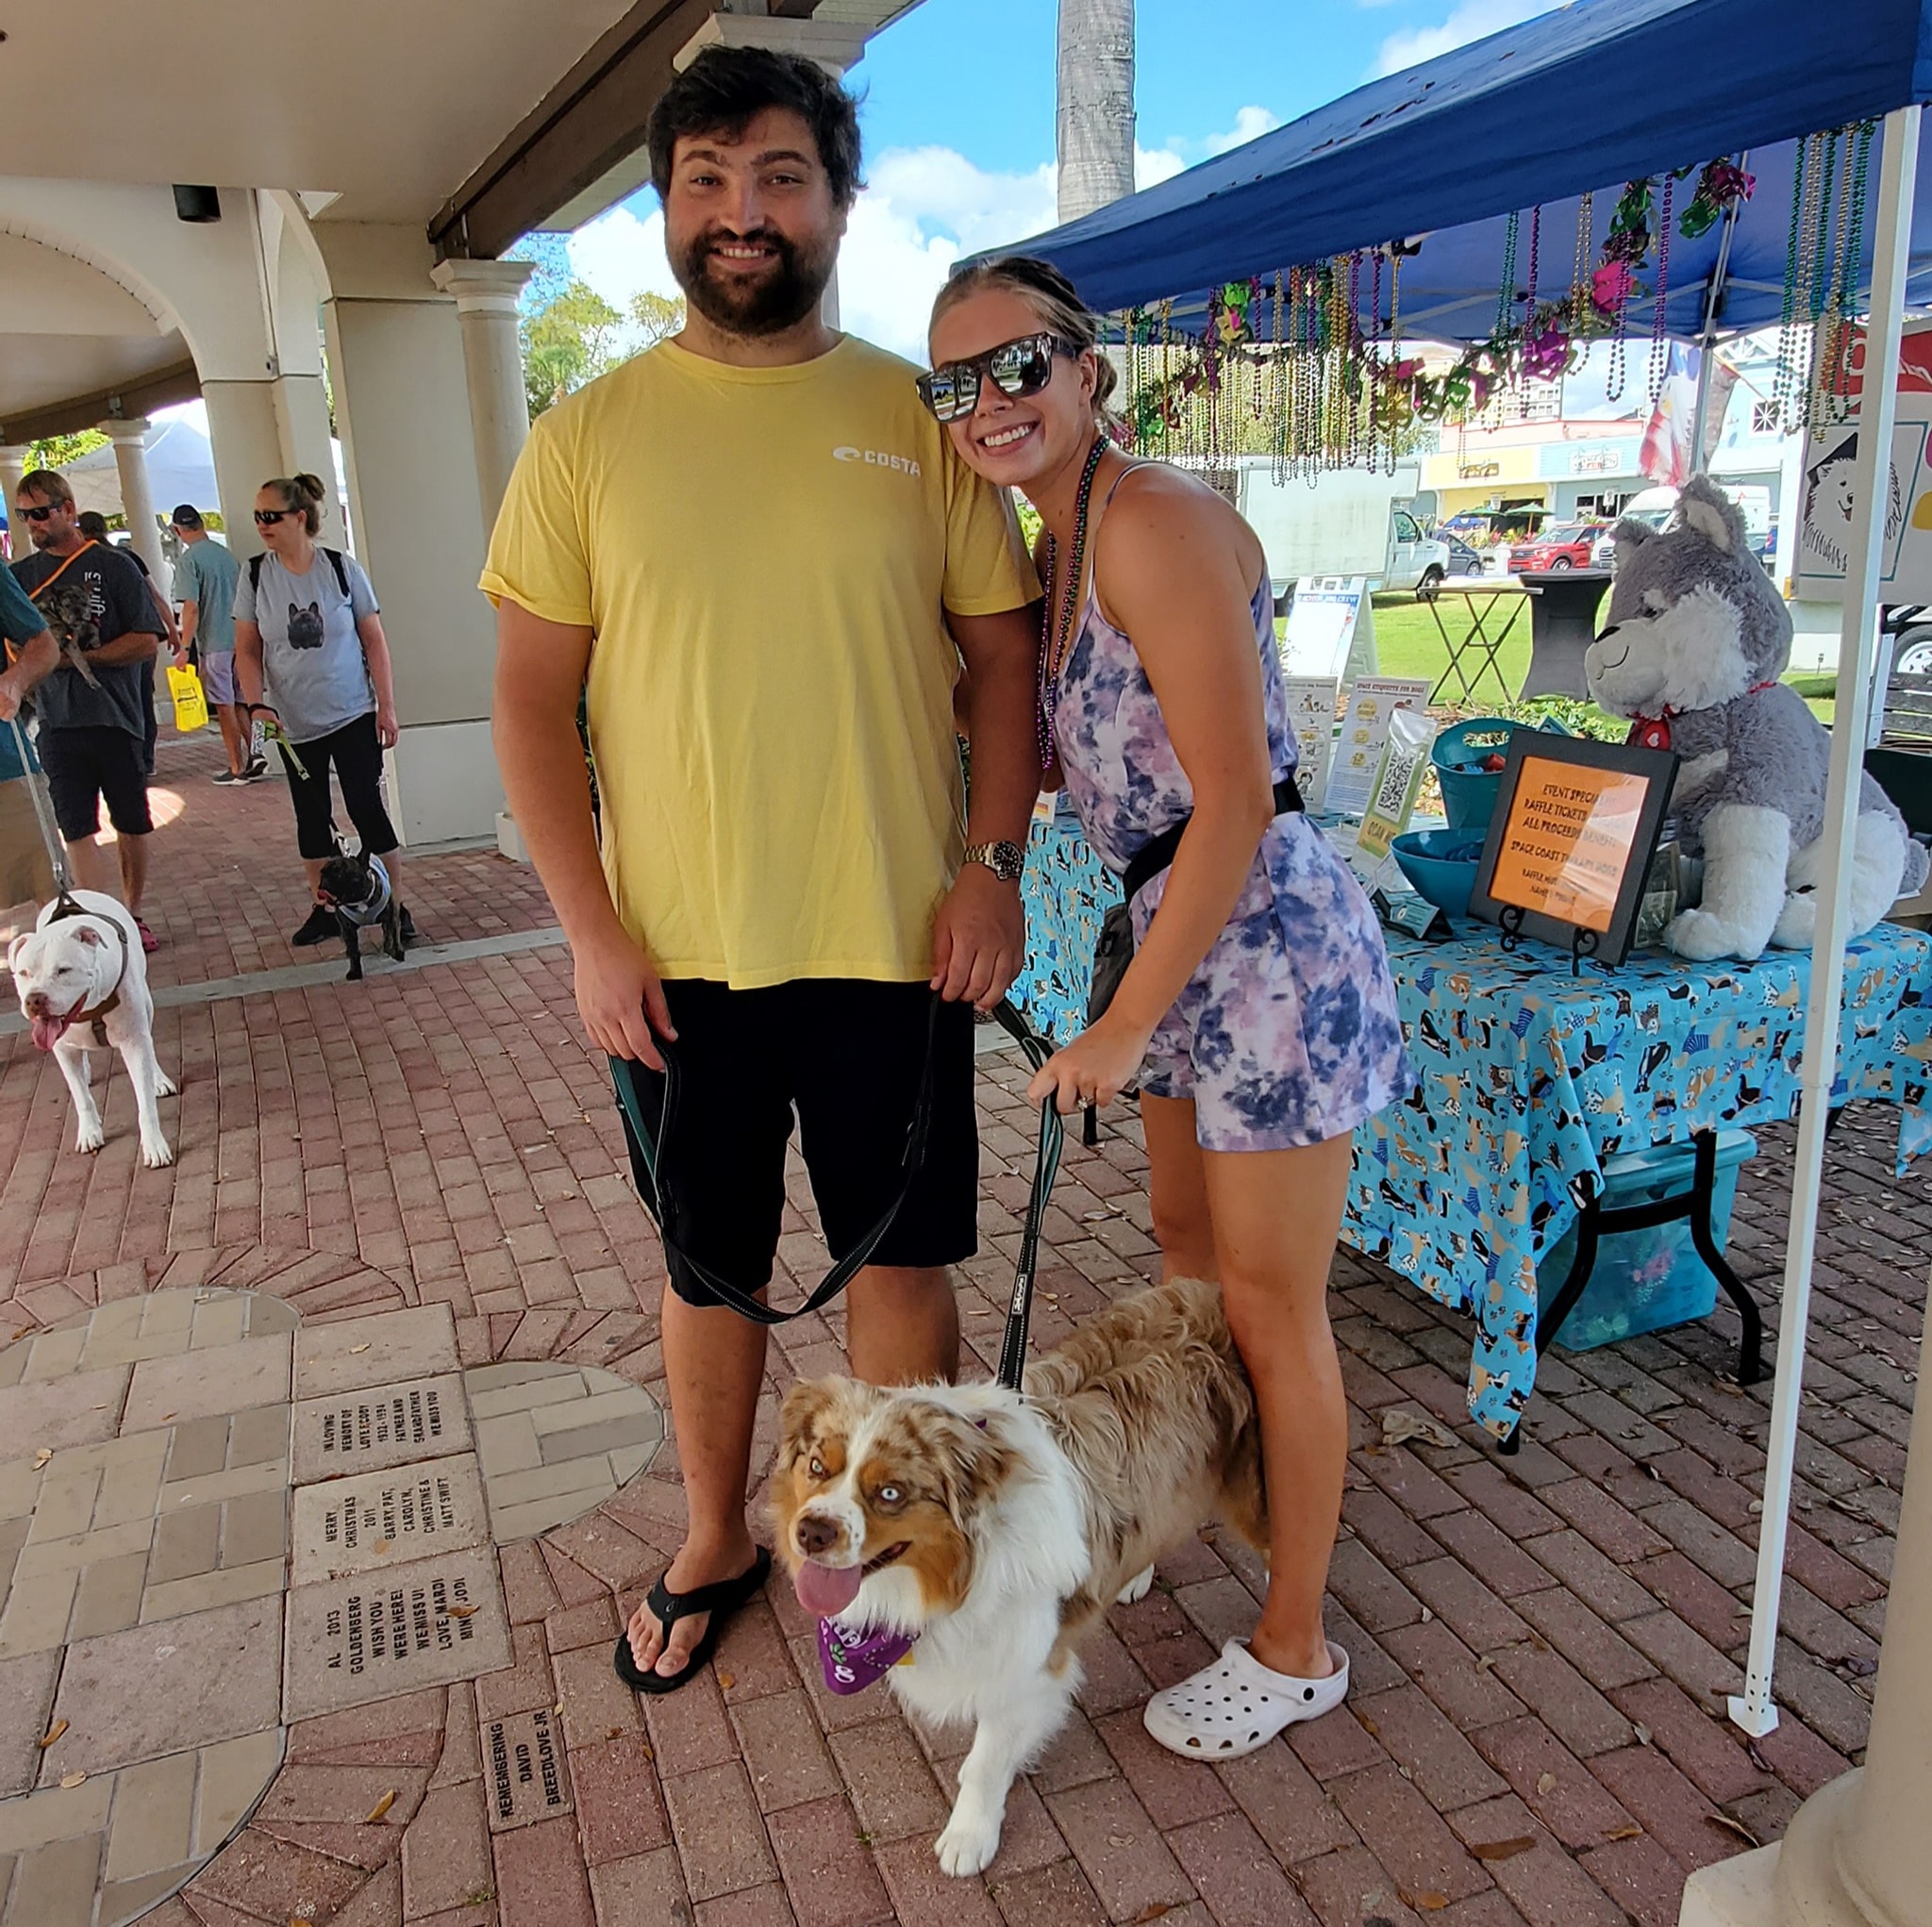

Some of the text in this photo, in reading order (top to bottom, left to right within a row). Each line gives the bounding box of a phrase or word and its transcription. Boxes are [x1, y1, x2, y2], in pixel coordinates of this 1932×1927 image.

[864, 450, 921, 478] COSTA
[1524, 798, 1554, 815] RAFFLE
[1555, 805, 1588, 822] TICKETS
[1542, 784, 1572, 800] EVENT
[1523, 816, 1540, 830] ALL
[1510, 840, 1535, 856] SPACE
[1535, 847, 1560, 862] COAST
[1522, 869, 1543, 882] RAFFLE
[324, 1414, 335, 1453] IN LOVING
[341, 1409, 353, 1453] MEMORY OF
[392, 1398, 408, 1442] FATHER AND
[409, 1390, 425, 1444] GRANDFATHER
[426, 1391, 442, 1437] WE MISS YOU
[343, 1496, 358, 1549] CHRISTMAS
[364, 1508, 376, 1528] 2011
[382, 1488, 396, 1540] BARRY, PAT,
[401, 1488, 415, 1532] CAROLYN,
[420, 1487, 436, 1534] CHRISTINE
[437, 1476, 455, 1528] MATT SWIFT
[325, 1511, 338, 1543] MERRY
[431, 1578, 448, 1614] MARDI
[453, 1577, 470, 1603] JODI
[348, 1596, 364, 1675] GOLDENBERG
[369, 1601, 386, 1658] WISH YOU
[390, 1589, 408, 1660] WERE HERE!
[413, 1603, 428, 1630] MISS
[326, 1609, 341, 1669] AL 2013
[416, 1630, 430, 1651] WE
[491, 1722, 514, 1818] REMEMBERING
[515, 1743, 533, 1784] DAVID
[533, 1709, 561, 1807] BREEDLOVE JR
